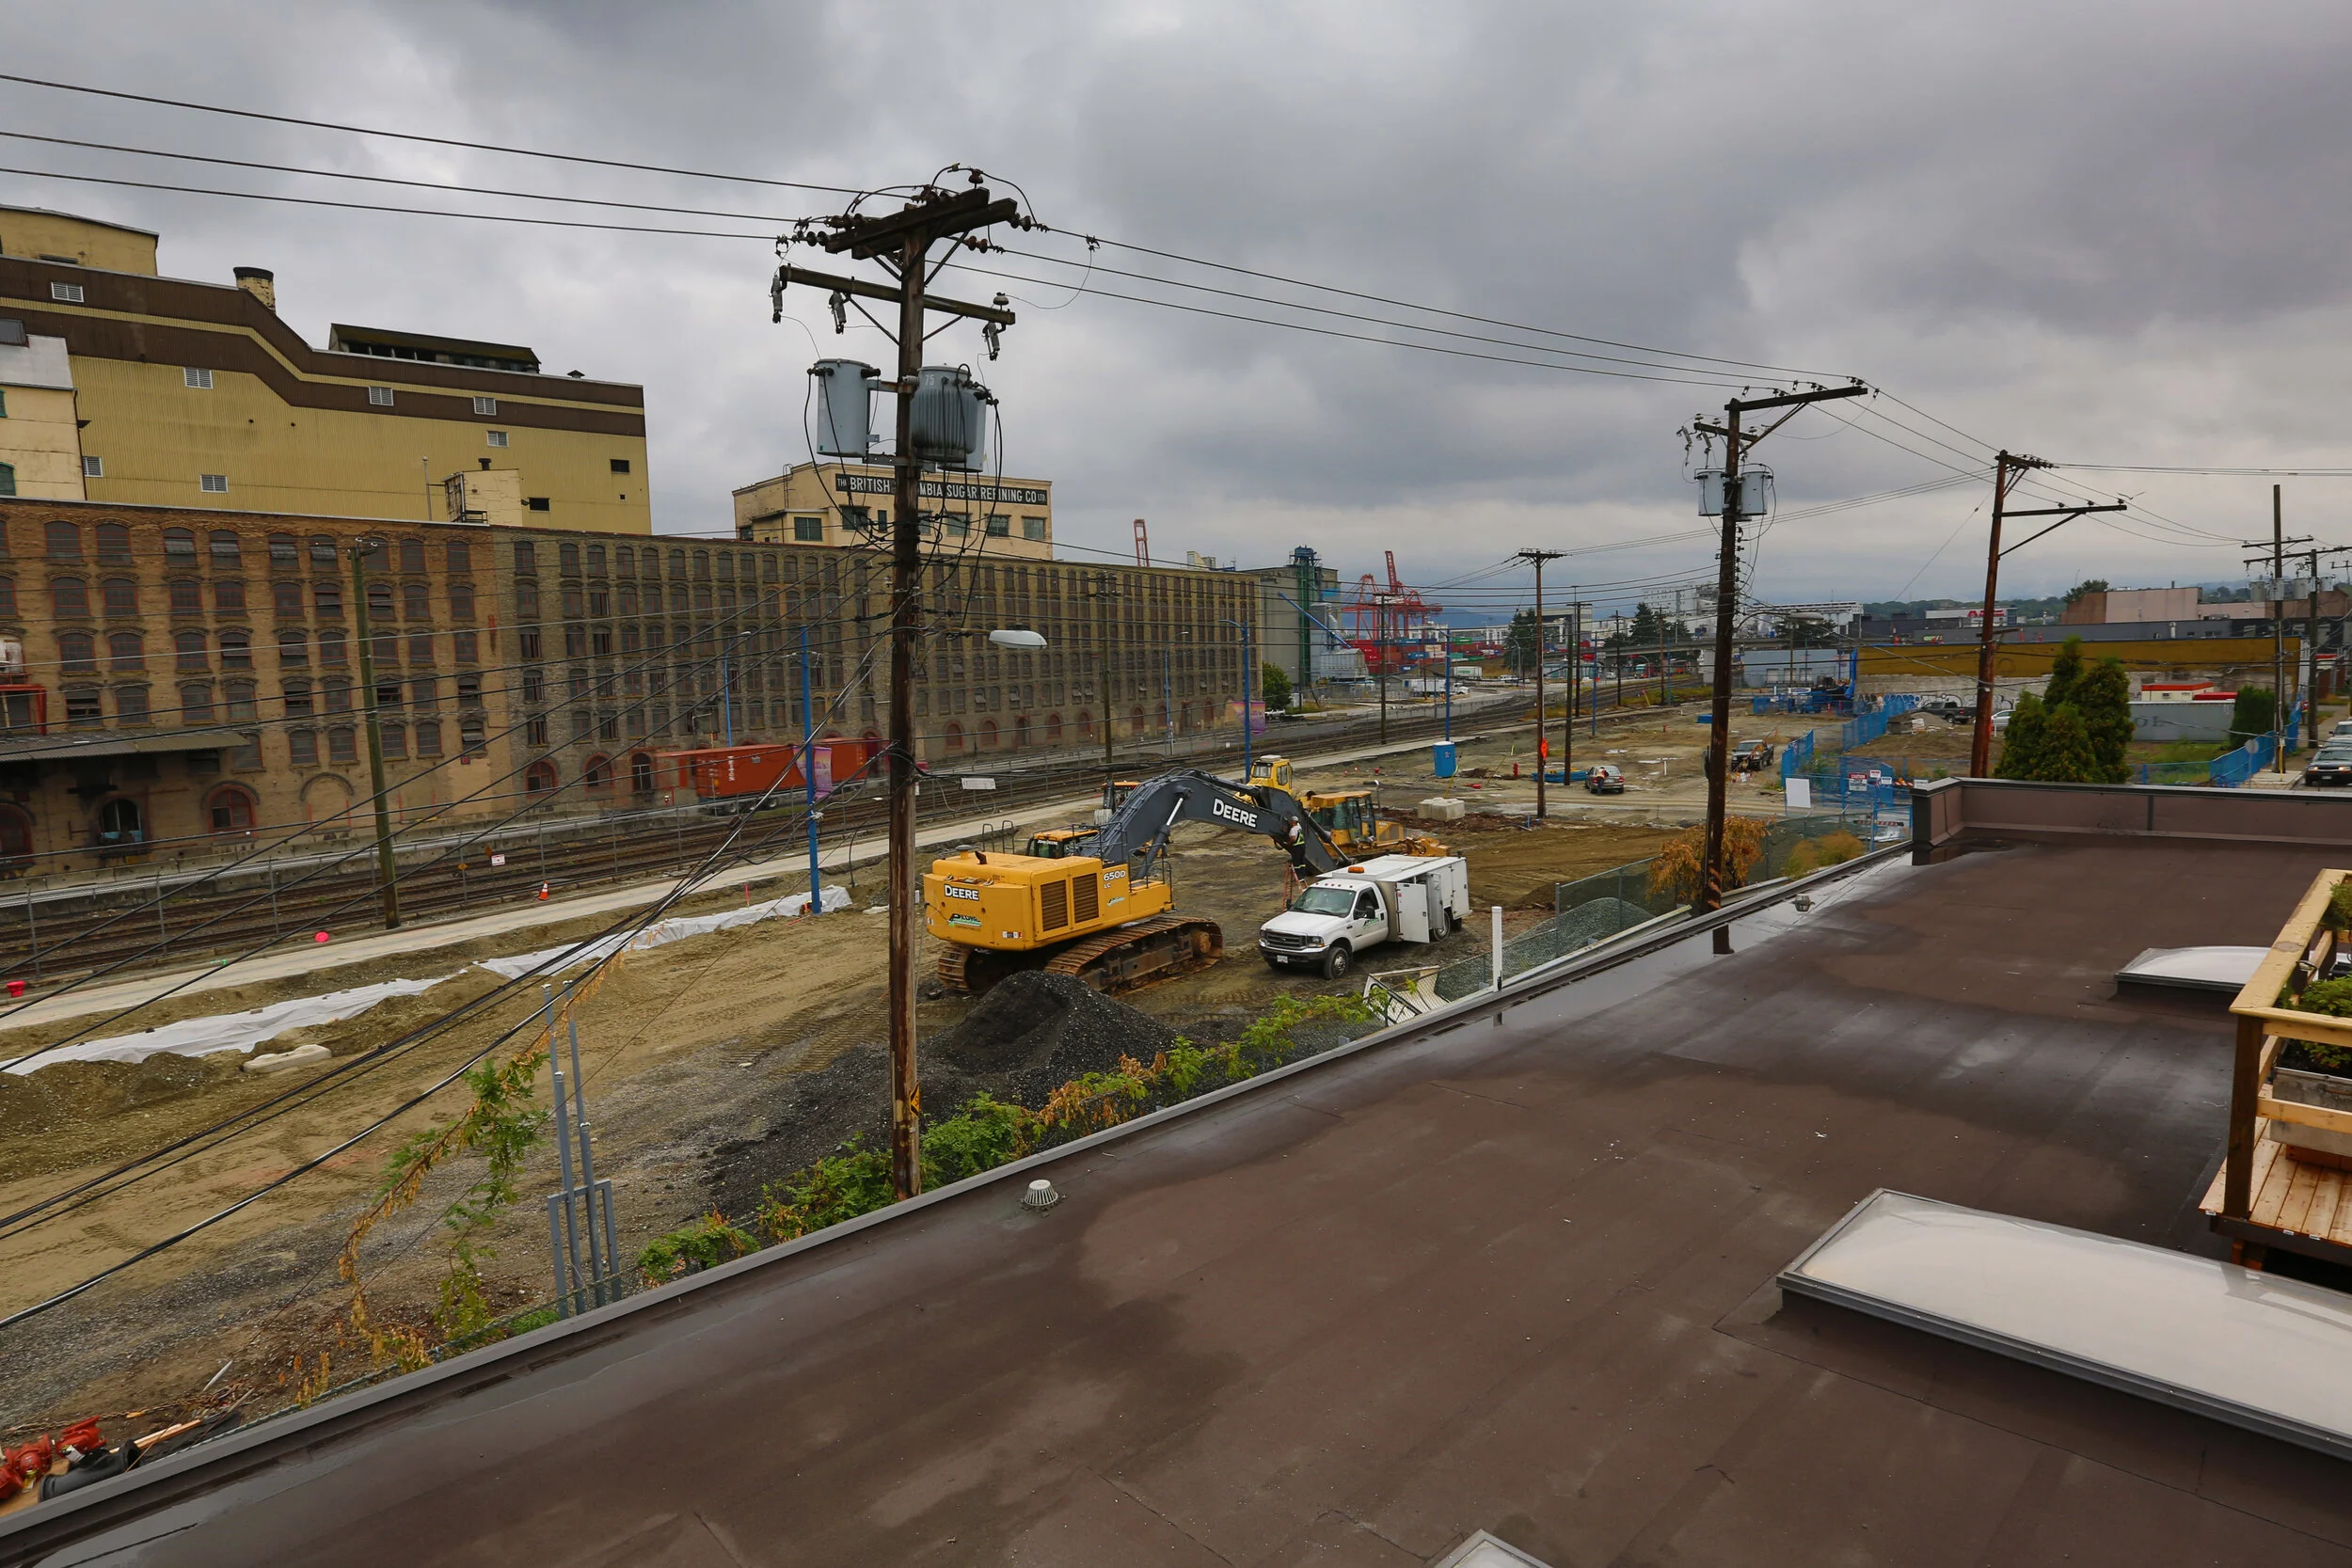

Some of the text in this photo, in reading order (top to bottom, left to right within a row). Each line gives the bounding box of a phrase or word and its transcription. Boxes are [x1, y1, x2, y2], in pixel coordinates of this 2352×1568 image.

[850, 477, 890, 493] BRITISH
[946, 484, 977, 499] SUGAR
[980, 487, 1024, 502] REFINING
[1025, 490, 1037, 503] CO
[1213, 798, 1258, 828] DEERE
[1104, 870, 1126, 881] 650D
[944, 884, 979, 901] DEERE
